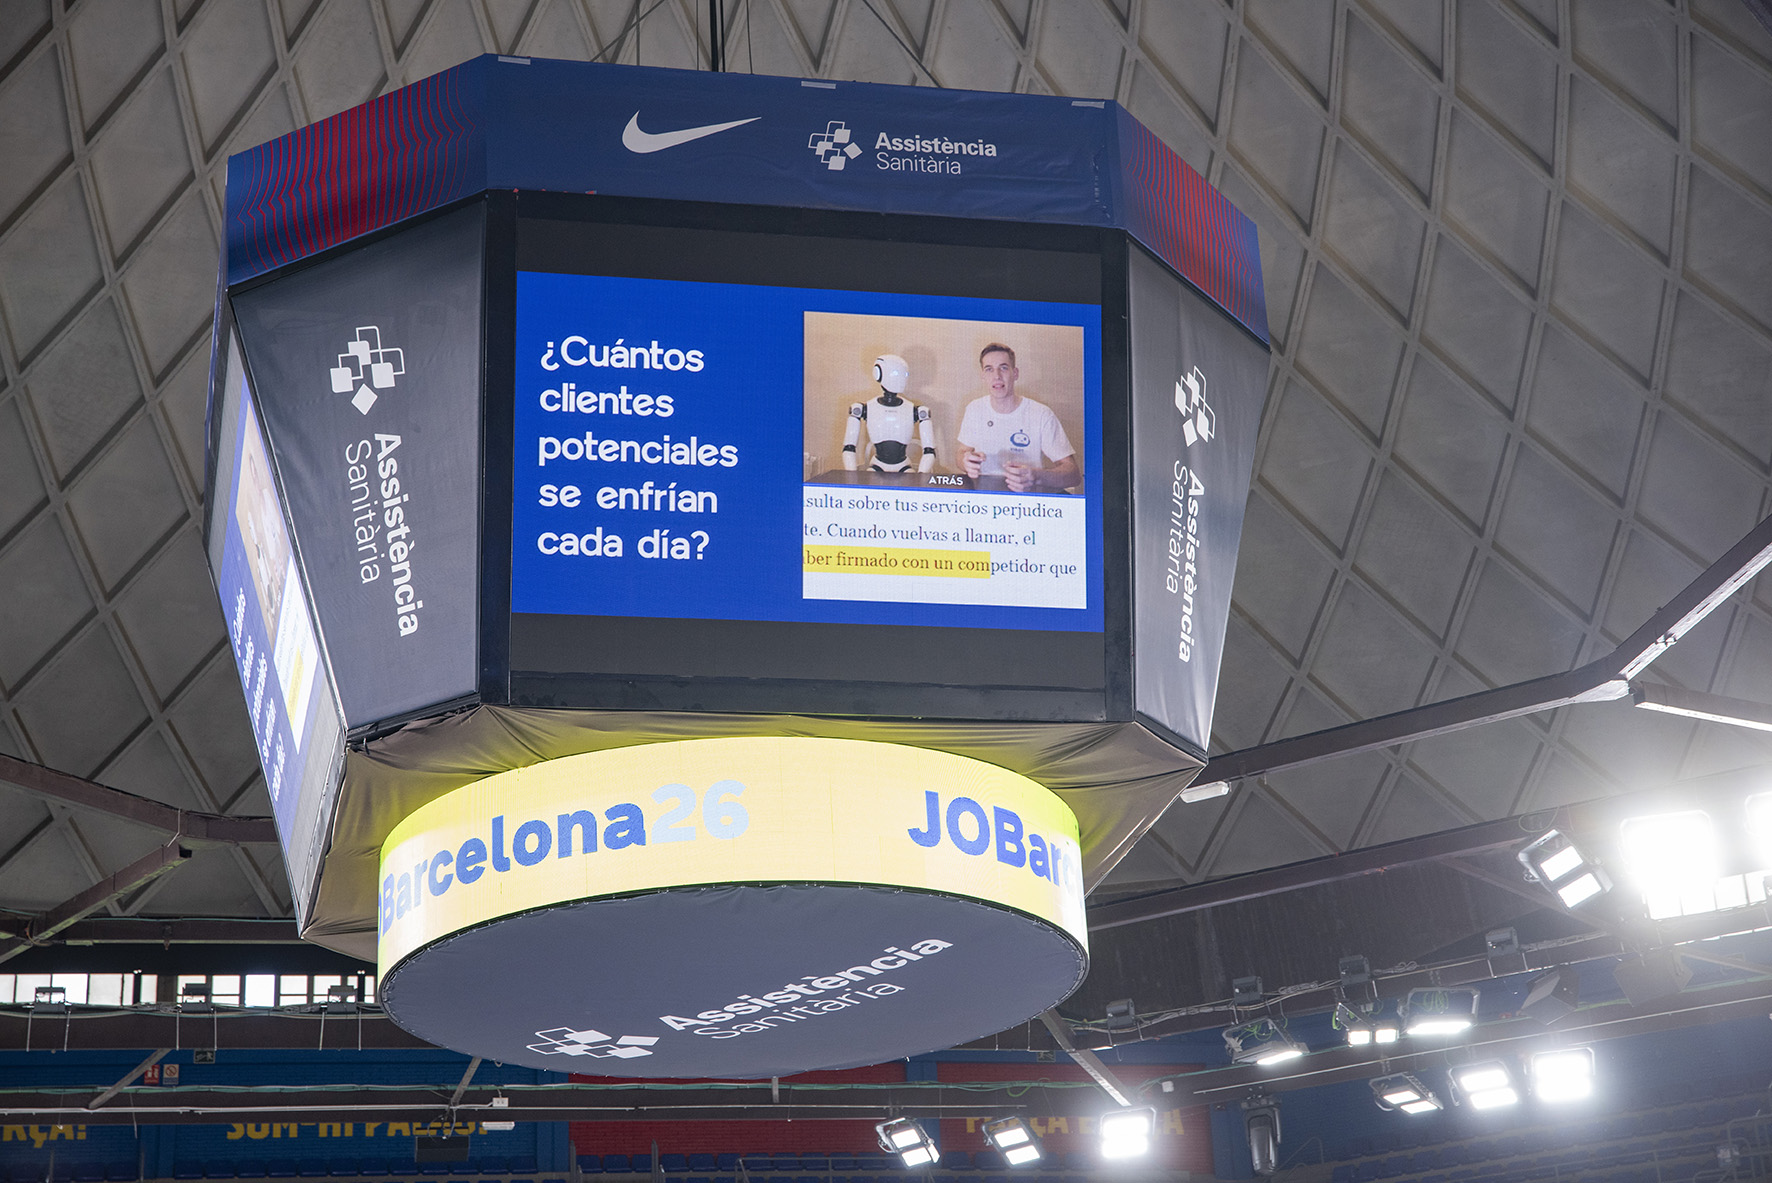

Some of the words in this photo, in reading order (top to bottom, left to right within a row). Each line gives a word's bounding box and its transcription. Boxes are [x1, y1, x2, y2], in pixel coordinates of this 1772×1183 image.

[875, 132, 997, 157] Assistència
[876, 152, 961, 174] Sanitària
[540, 335, 705, 372] ¿Cuántos
[539, 382, 674, 417] clientes
[538, 431, 739, 467] potenciales
[538, 483, 582, 508] se
[596, 481, 718, 513] enfrían
[928, 475, 964, 486] ATRÁS
[345, 439, 386, 584] Sanitària
[803, 494, 843, 509] sulta
[848, 496, 890, 511] sobre
[895, 498, 918, 512] tus
[922, 500, 988, 515] servicios
[992, 502, 1063, 520] perjudica
[374, 433, 424, 637] Assistència
[537, 527, 623, 557] cada
[637, 528, 710, 560] día?
[827, 523, 887, 539] Cuando
[891, 526, 948, 542] vuelvas
[952, 532, 963, 543] a
[965, 528, 1019, 546] llamar,
[1023, 531, 1036, 545] el
[1166, 460, 1188, 594] Sanitària
[803, 550, 832, 566] ber
[836, 552, 898, 568] firmado
[902, 557, 929, 570] con
[934, 559, 954, 571] un
[958, 558, 1046, 575] competidor
[1050, 564, 1077, 578] que
[1178, 469, 1205, 663] Assistència
[378, 780, 749, 946] Barcelona26
[659, 938, 954, 1031] Assistència
[693, 981, 905, 1040] Sanitària
